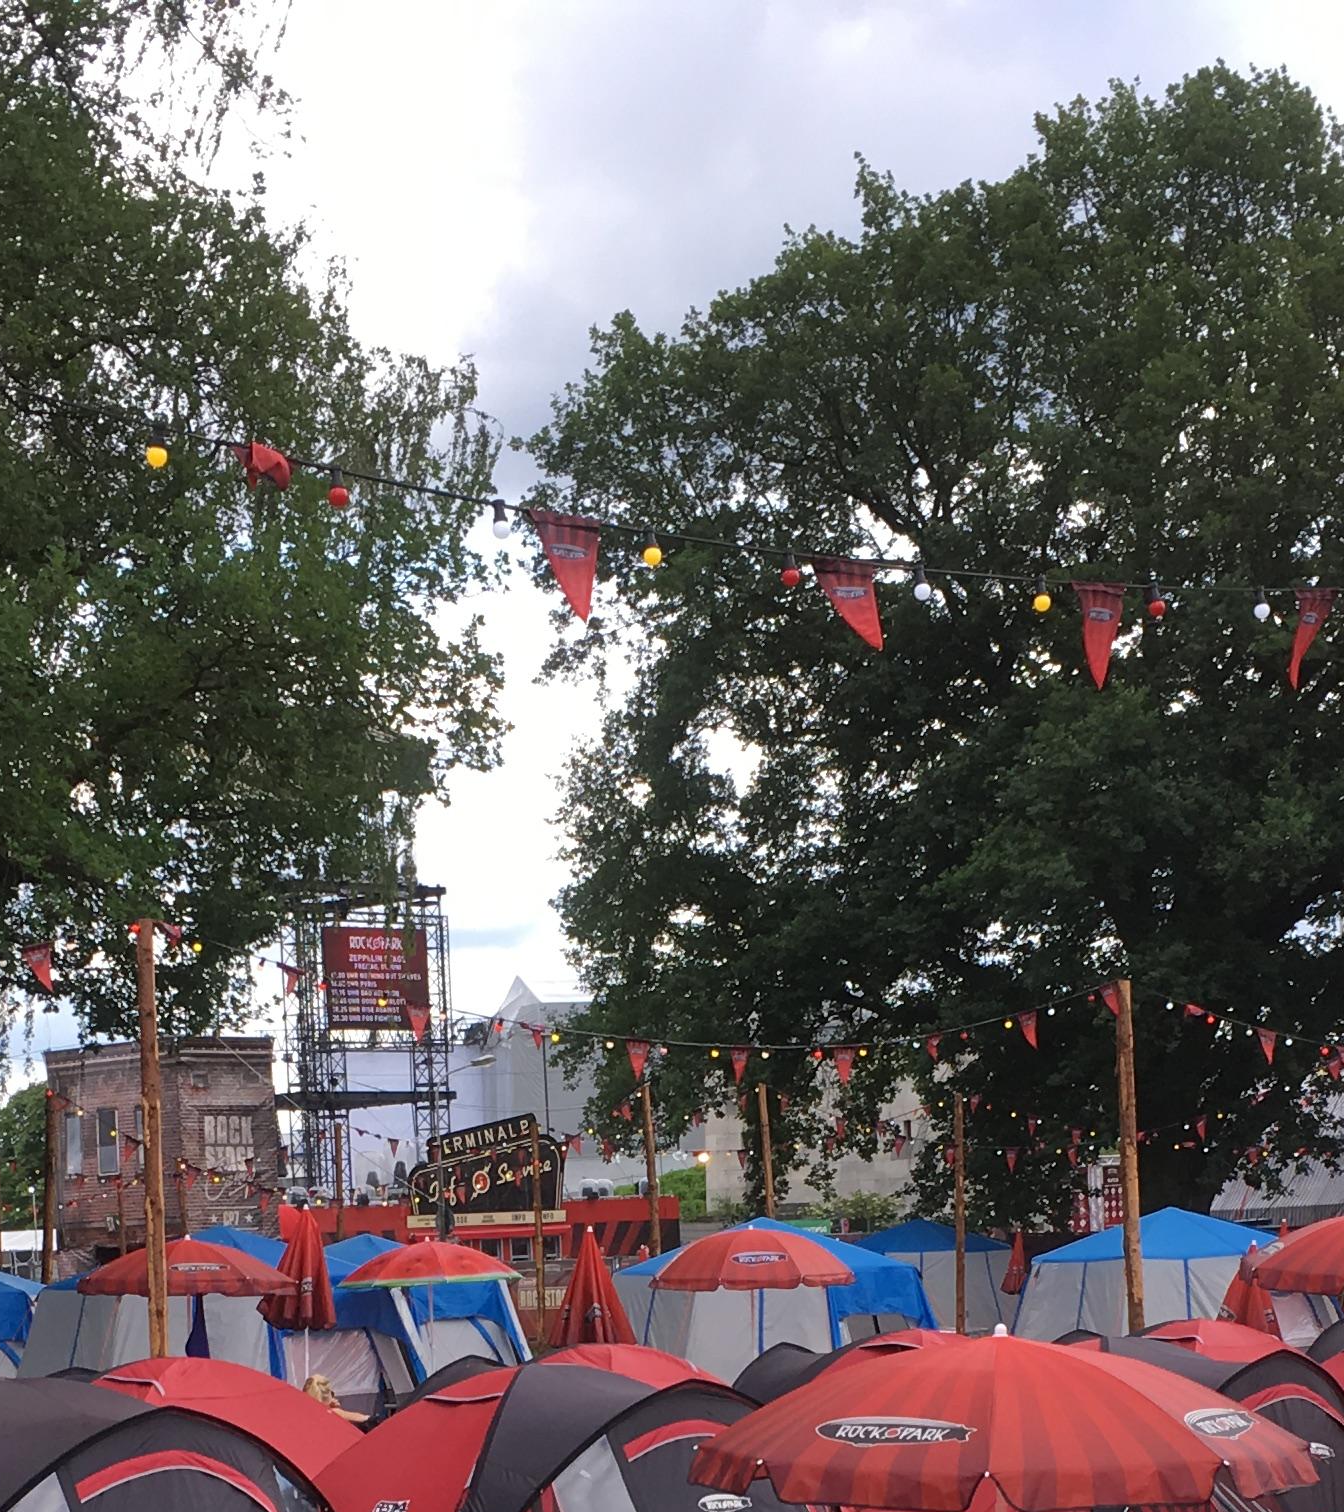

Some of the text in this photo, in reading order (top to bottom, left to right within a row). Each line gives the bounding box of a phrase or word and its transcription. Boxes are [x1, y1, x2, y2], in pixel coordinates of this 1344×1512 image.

[204, 1115, 253, 1144] BACK
[836, 1425, 951, 1441] ROCK PARK
